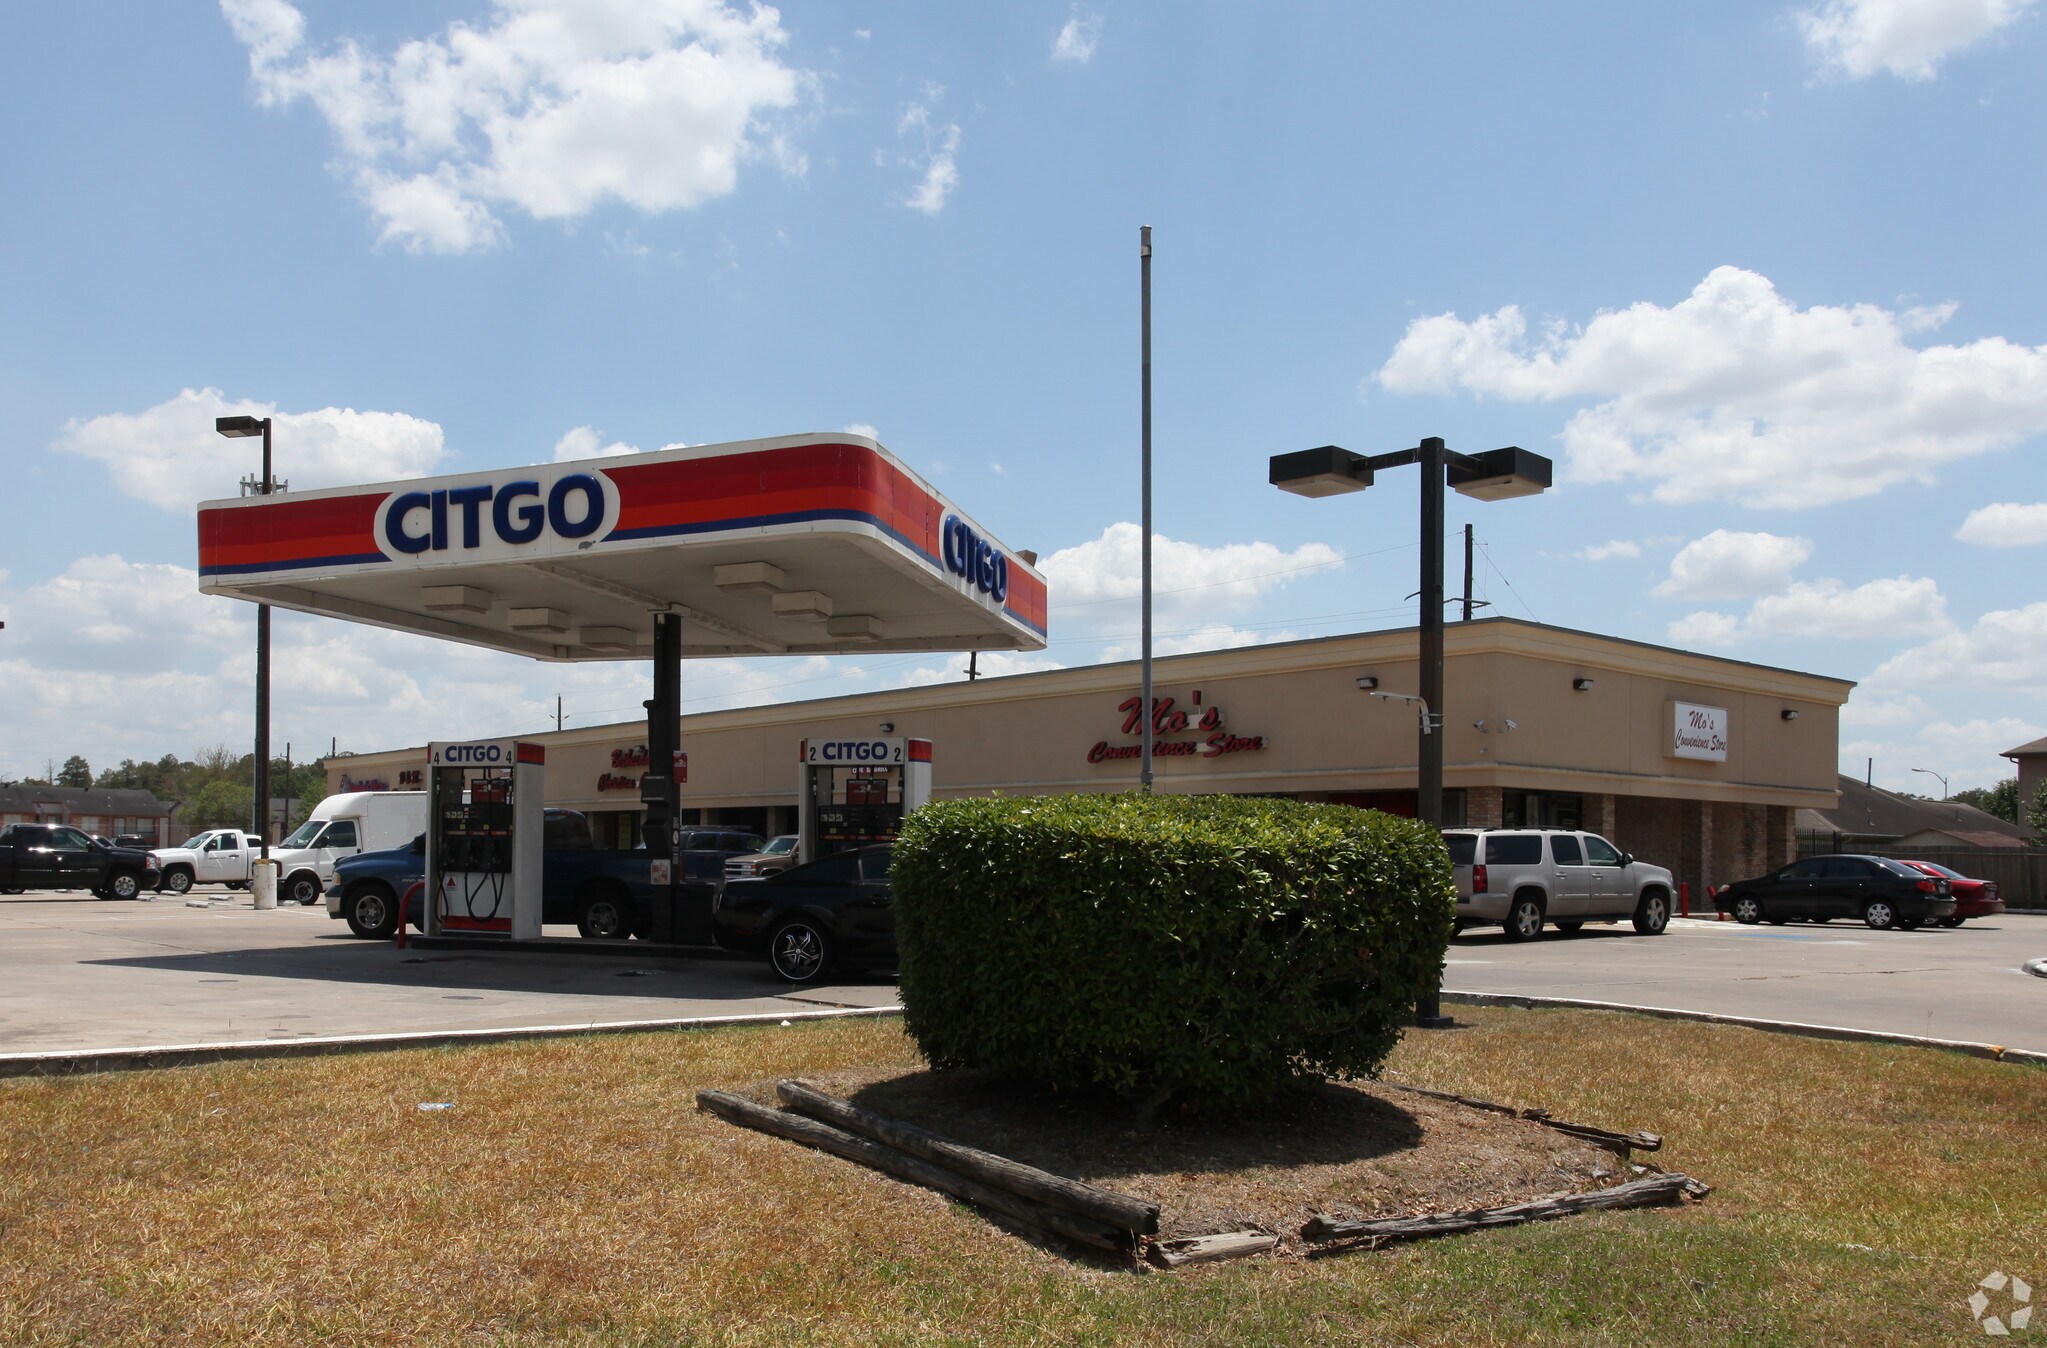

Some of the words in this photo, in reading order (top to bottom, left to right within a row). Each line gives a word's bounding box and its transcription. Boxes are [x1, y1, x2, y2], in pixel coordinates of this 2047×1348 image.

[385, 473, 605, 554] CITGO
[944, 514, 1007, 602] CITGO
[1118, 690, 1223, 735] Mo's
[1689, 710, 1715, 730] Mo's
[1203, 733, 1264, 758] Store
[1675, 728, 1709, 749] Convenience
[1711, 734, 1726, 751] Store
[434, 752, 440, 764] 4
[446, 746, 500, 762] CITGO
[506, 751, 512, 763] 4
[810, 747, 816, 761] 2
[822, 742, 888, 760] CITGO
[894, 747, 901, 762] 2
